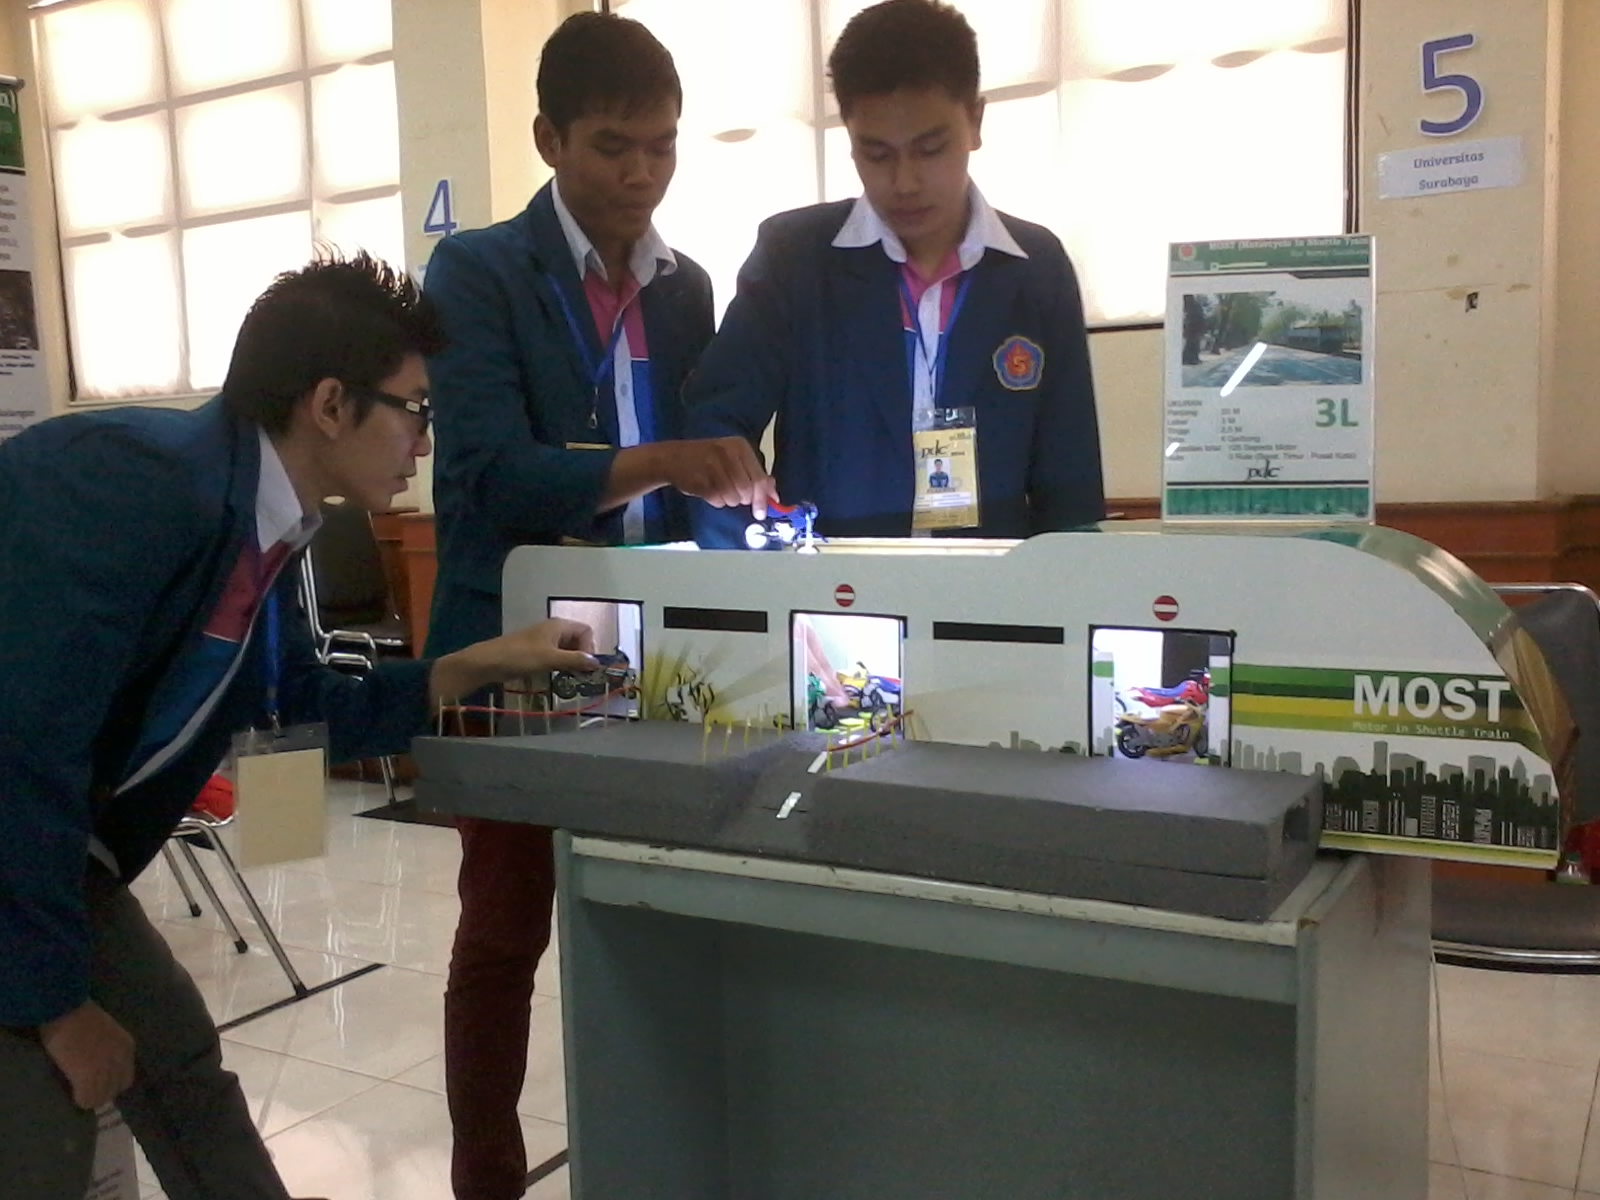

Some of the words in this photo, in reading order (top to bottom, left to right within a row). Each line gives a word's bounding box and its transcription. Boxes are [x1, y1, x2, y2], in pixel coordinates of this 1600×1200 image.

[1420, 34, 1482, 133] 5
[1413, 152, 1485, 169] Universitas
[1418, 175, 1480, 190] Surabaya
[424, 179, 457, 238] 4
[1315, 398, 1359, 428] 3L
[1353, 674, 1511, 723] MOST
[1352, 721, 1388, 732] Motor
[1394, 724, 1409, 734] in
[1416, 725, 1465, 737] Shuttle
[1473, 727, 1510, 739] Train
